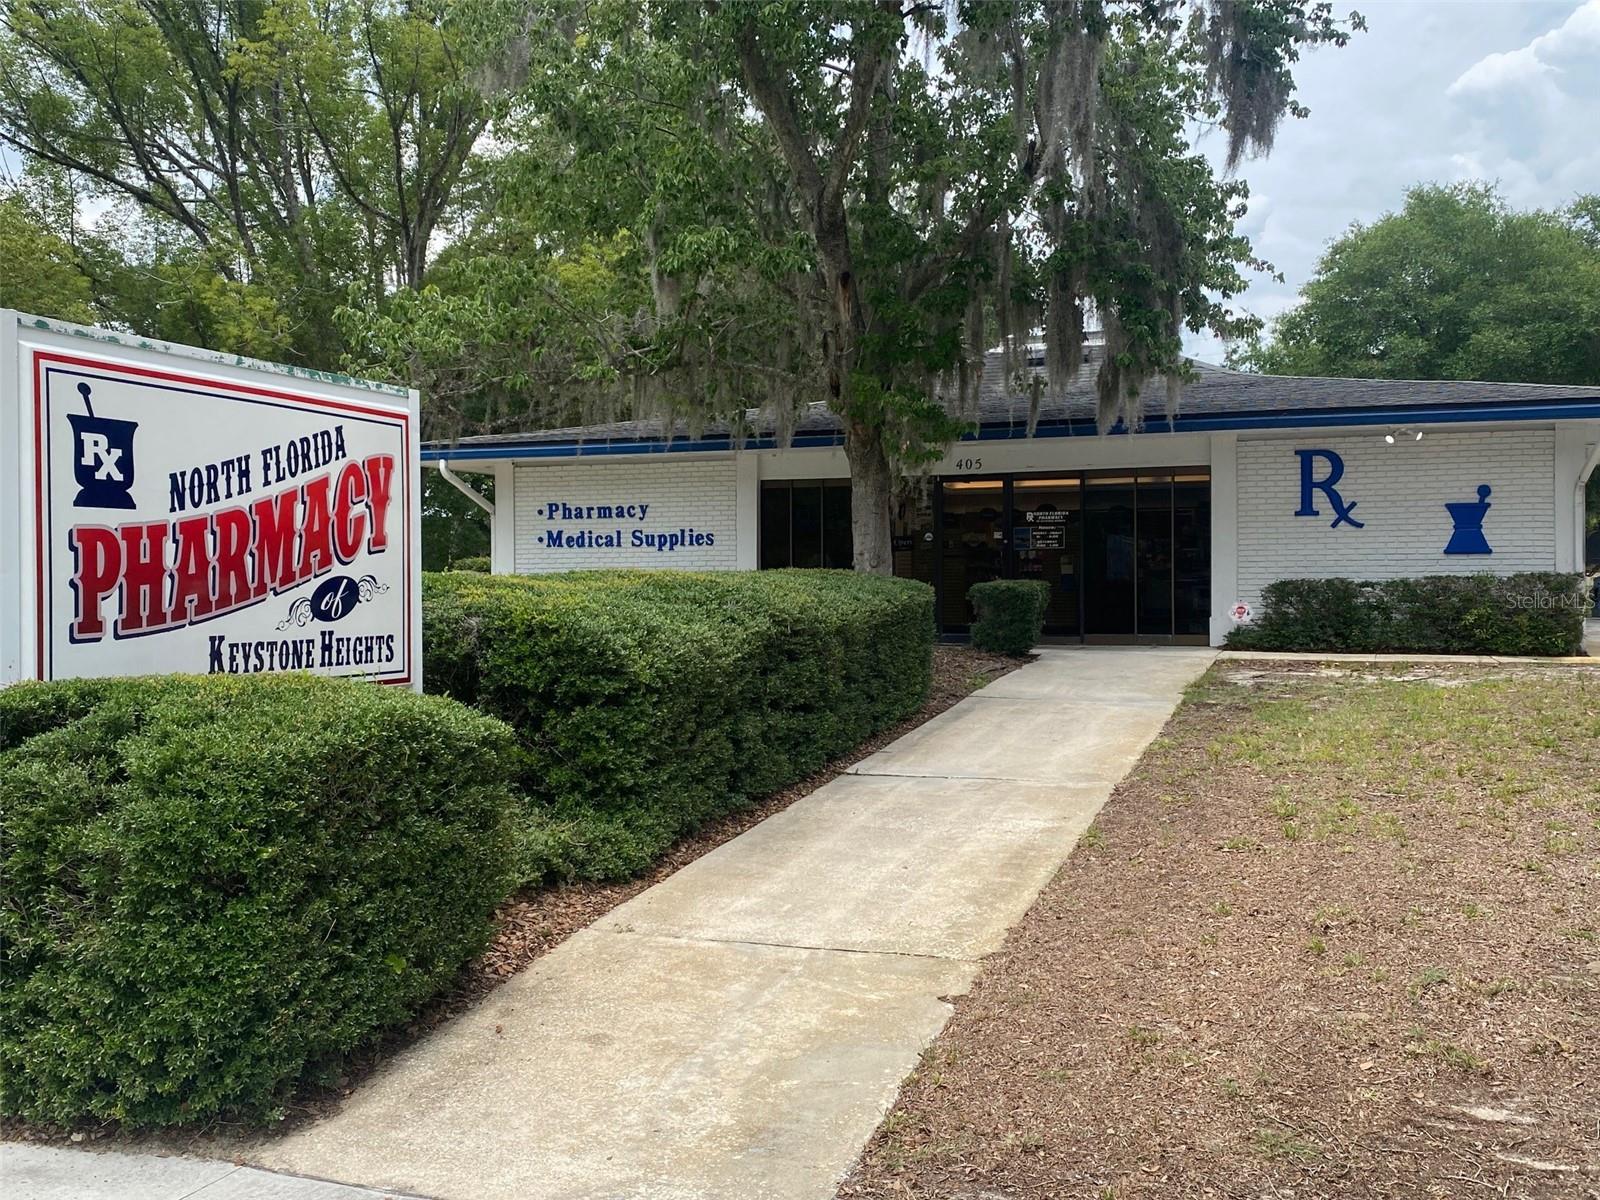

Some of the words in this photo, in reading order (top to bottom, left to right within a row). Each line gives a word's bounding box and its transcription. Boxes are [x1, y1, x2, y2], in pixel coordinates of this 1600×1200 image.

[169, 454, 251, 513] NORTH
[261, 425, 346, 487] FLORIDA
[955, 458, 982, 470] 405
[546, 502, 649, 520] Pharmacy
[69, 454, 394, 644] PHARMACY
[546, 530, 621, 548] Medical
[631, 528, 714, 551] Supplies
[320, 581, 348, 618] of
[208, 635, 315, 674] KEYSTONE
[319, 630, 394, 668] HEIGHTS
